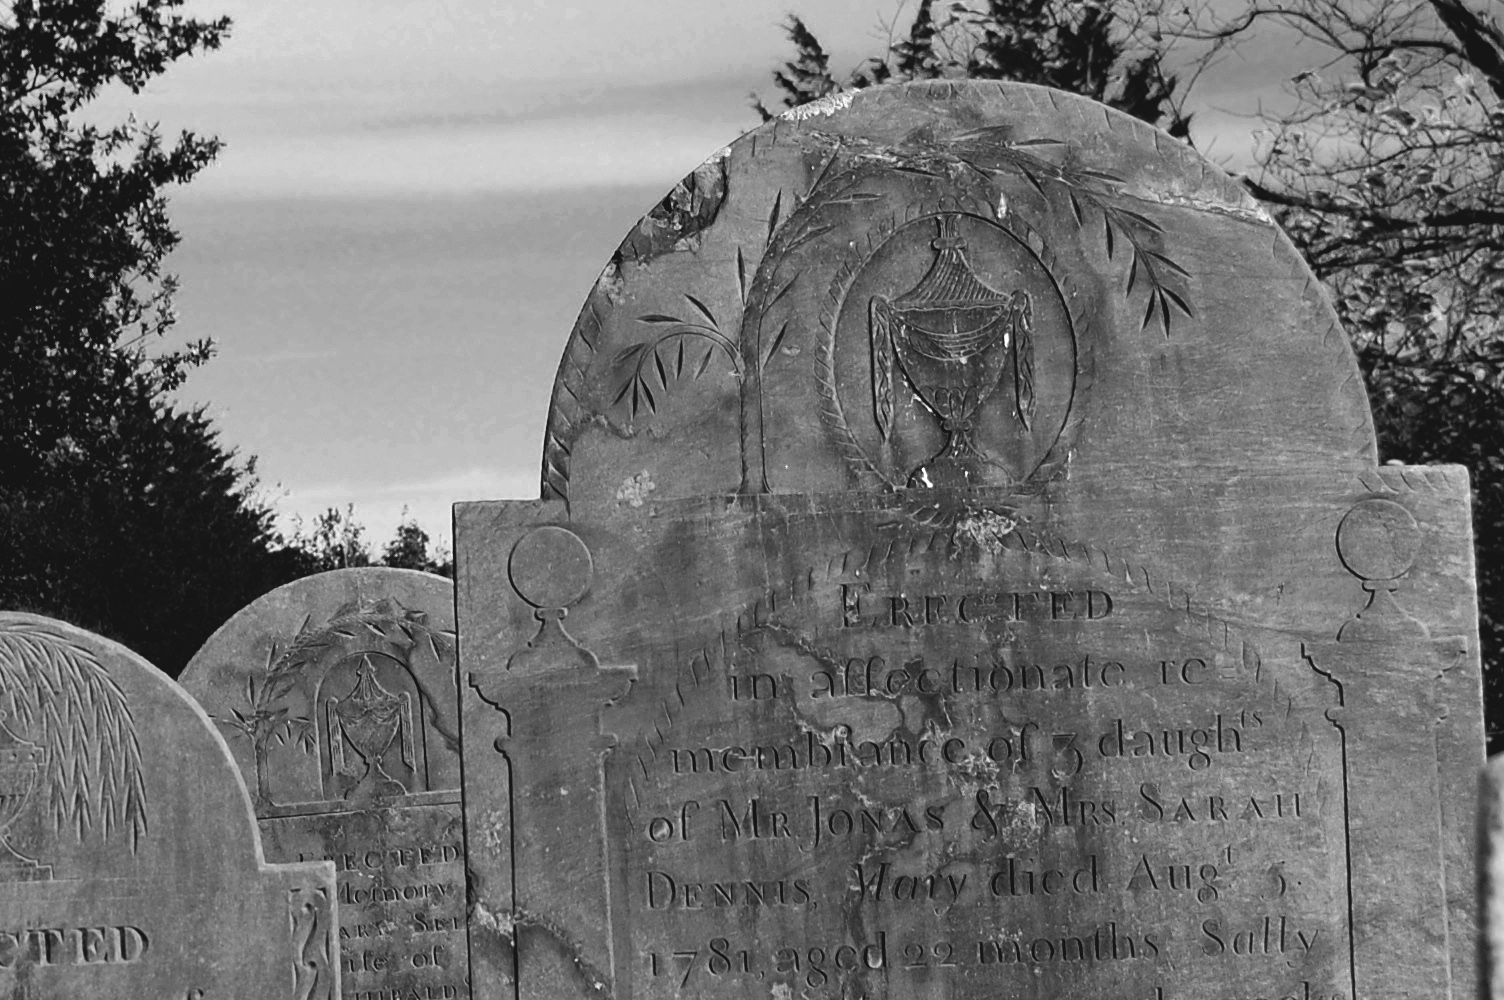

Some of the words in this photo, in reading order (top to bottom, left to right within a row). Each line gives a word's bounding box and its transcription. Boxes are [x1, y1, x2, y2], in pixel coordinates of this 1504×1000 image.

[730, 664, 777, 700] in
[810, 654, 1126, 699] affectionate
[988, 722, 1039, 763] of
[1052, 732, 1084, 776] 3
[648, 800, 700, 842] of
[971, 789, 1000, 843] &
[852, 862, 967, 917] Mary
[990, 855, 1098, 897] died
[412, 945, 445, 969] of
[776, 931, 886, 988] aged
[904, 942, 956, 968] 22
[978, 921, 1159, 965] months
[1201, 916, 1319, 969] Sally
